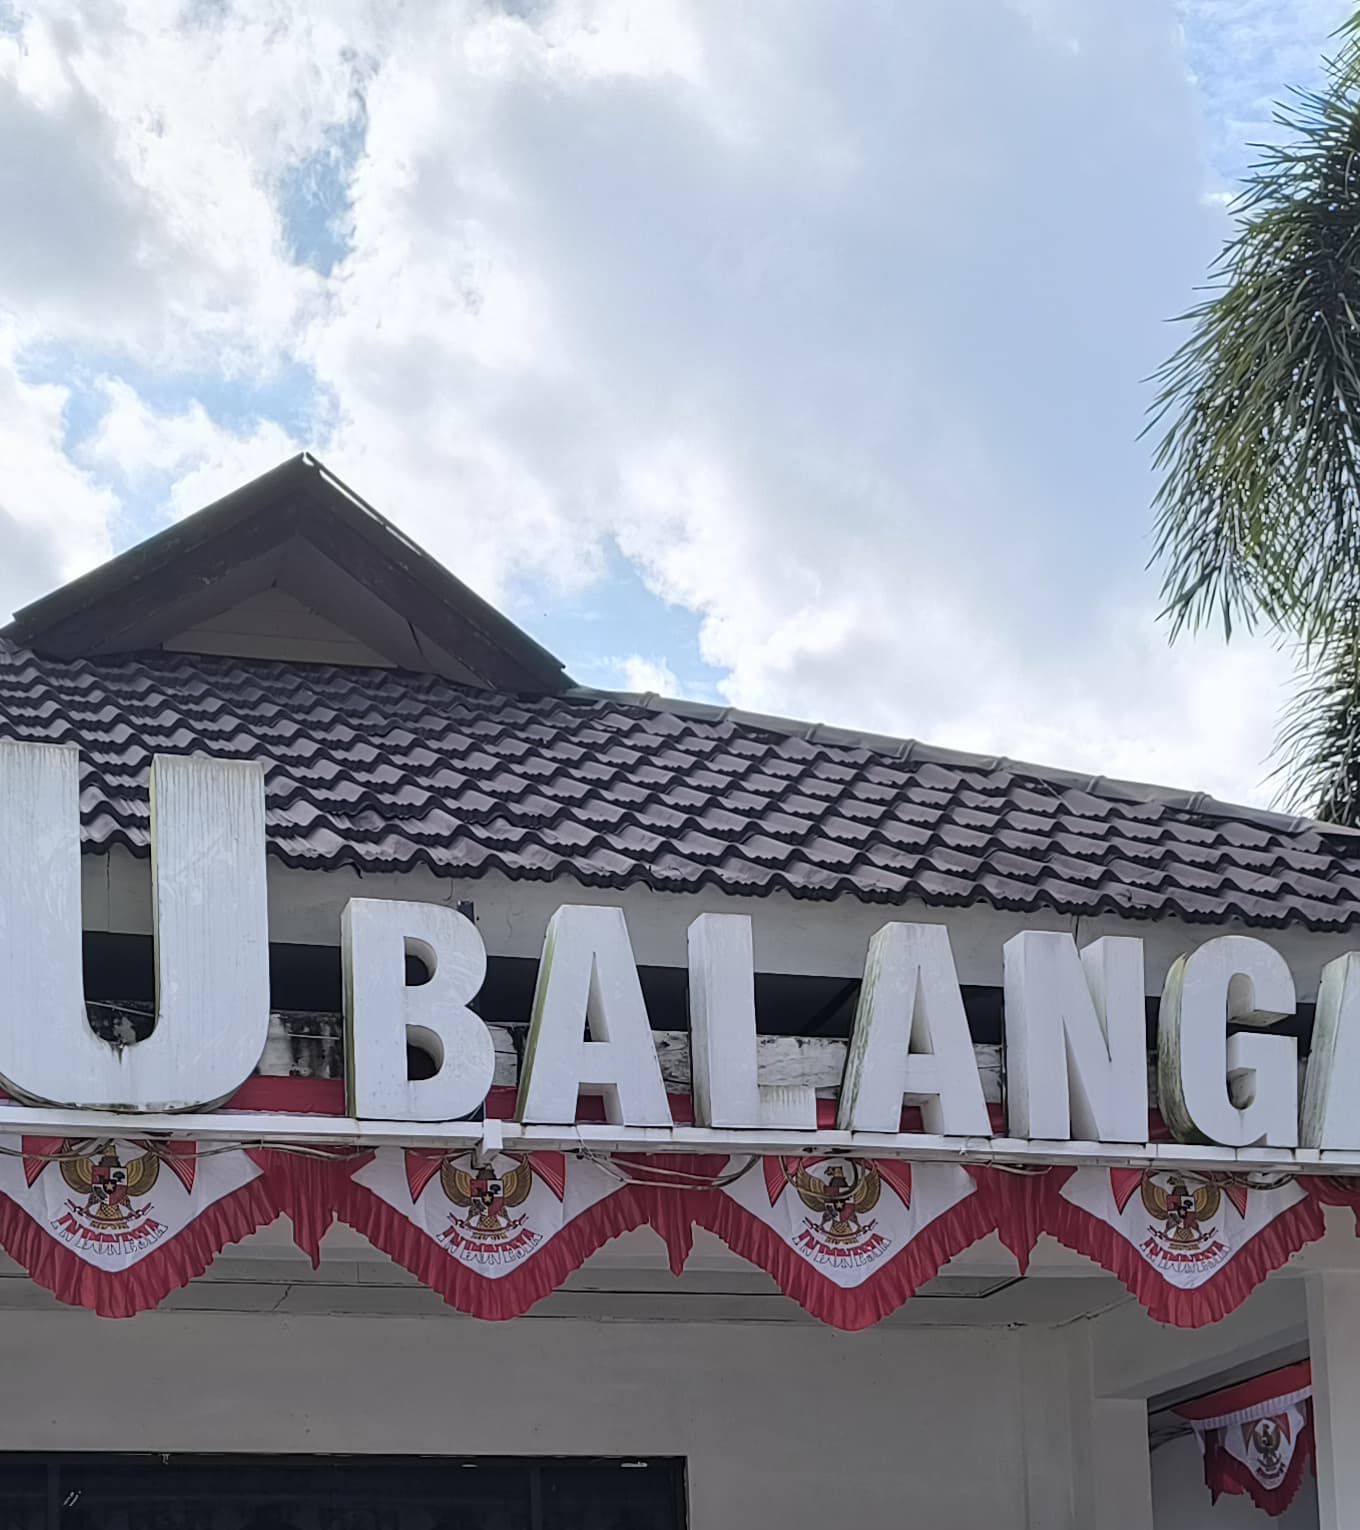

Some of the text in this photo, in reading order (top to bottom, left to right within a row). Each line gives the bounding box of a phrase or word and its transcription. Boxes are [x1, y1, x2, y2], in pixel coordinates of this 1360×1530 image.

[50, 1212, 169, 1256] INDONESIA
[436, 1225, 544, 1266] INDONESIA
[791, 1229, 892, 1269] INDONESIA
